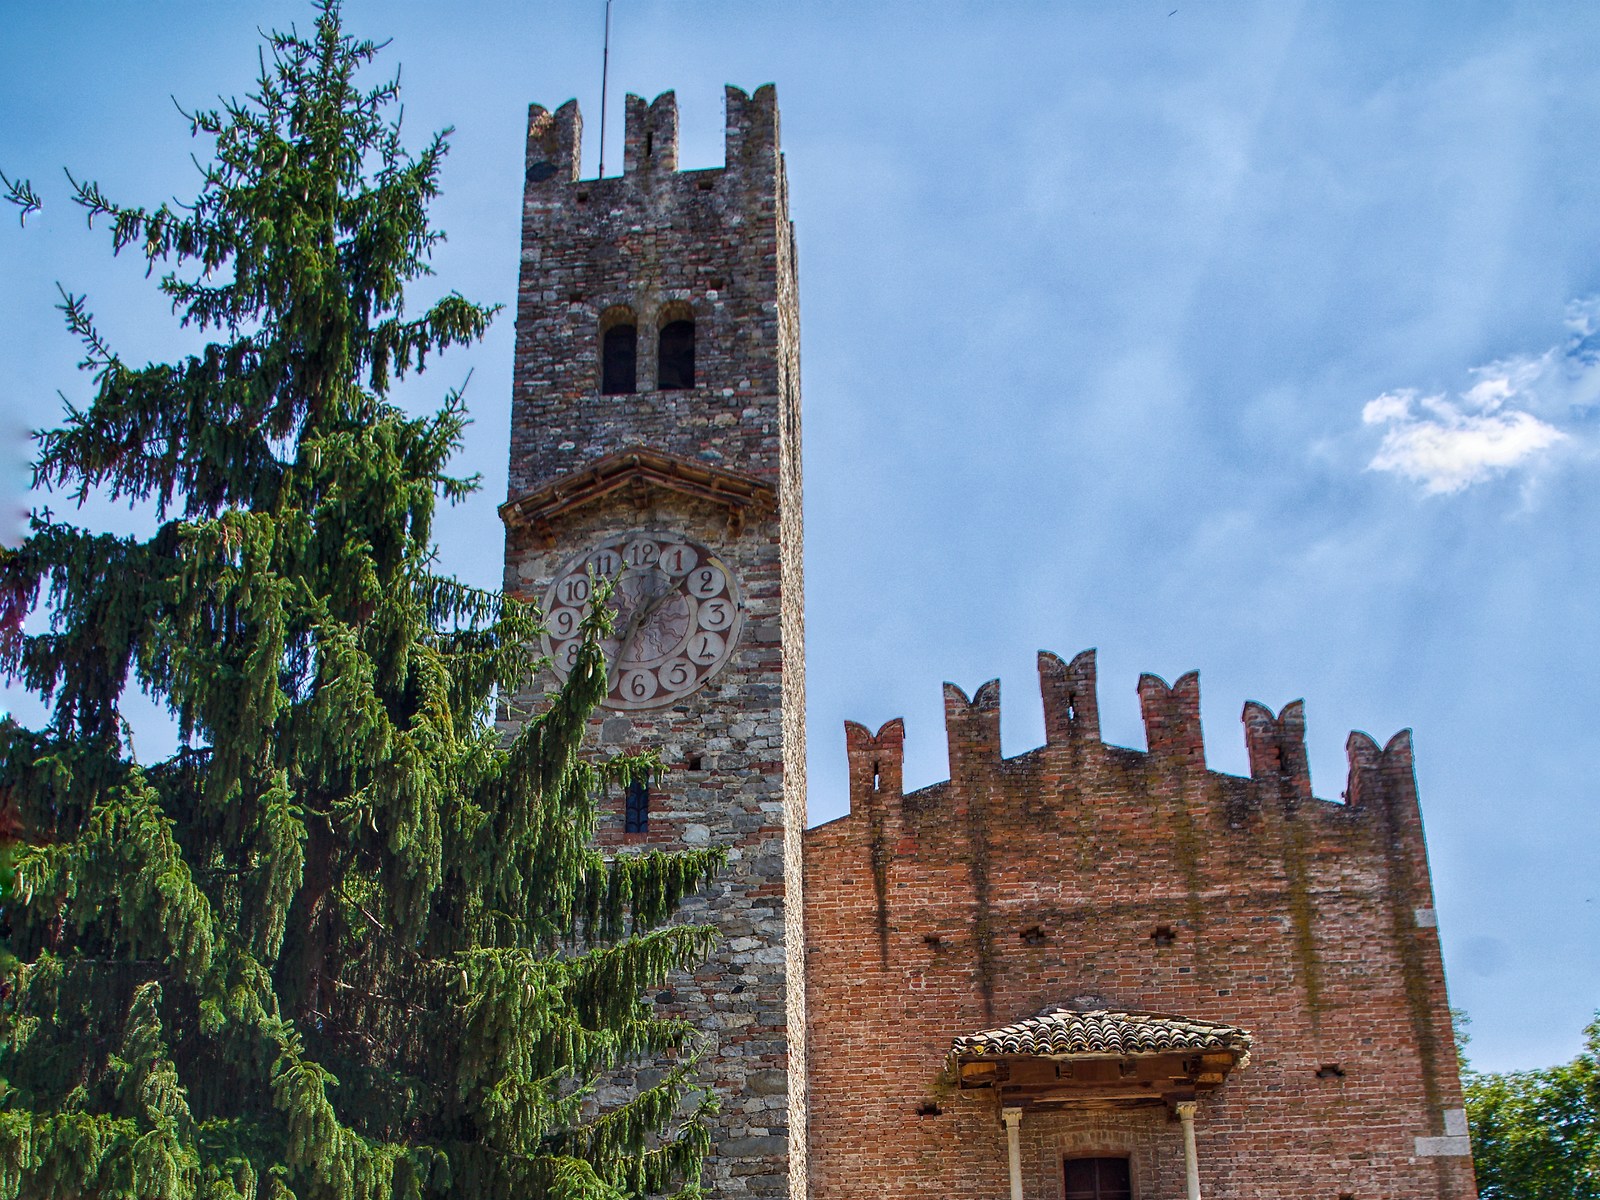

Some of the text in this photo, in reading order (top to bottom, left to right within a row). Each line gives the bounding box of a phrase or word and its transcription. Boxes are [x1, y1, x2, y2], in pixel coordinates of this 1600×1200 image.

[595, 554, 612, 575] 11
[632, 543, 653, 566] 12
[674, 549, 683, 572] 1
[565, 579, 588, 600] 10
[700, 571, 713, 593] 2
[557, 611, 573, 635] 9
[708, 604, 725, 625] 3
[567, 644, 579, 666] 8
[698, 636, 715, 660] 4
[669, 663, 687, 685] 5
[631, 674, 645, 697] 6
